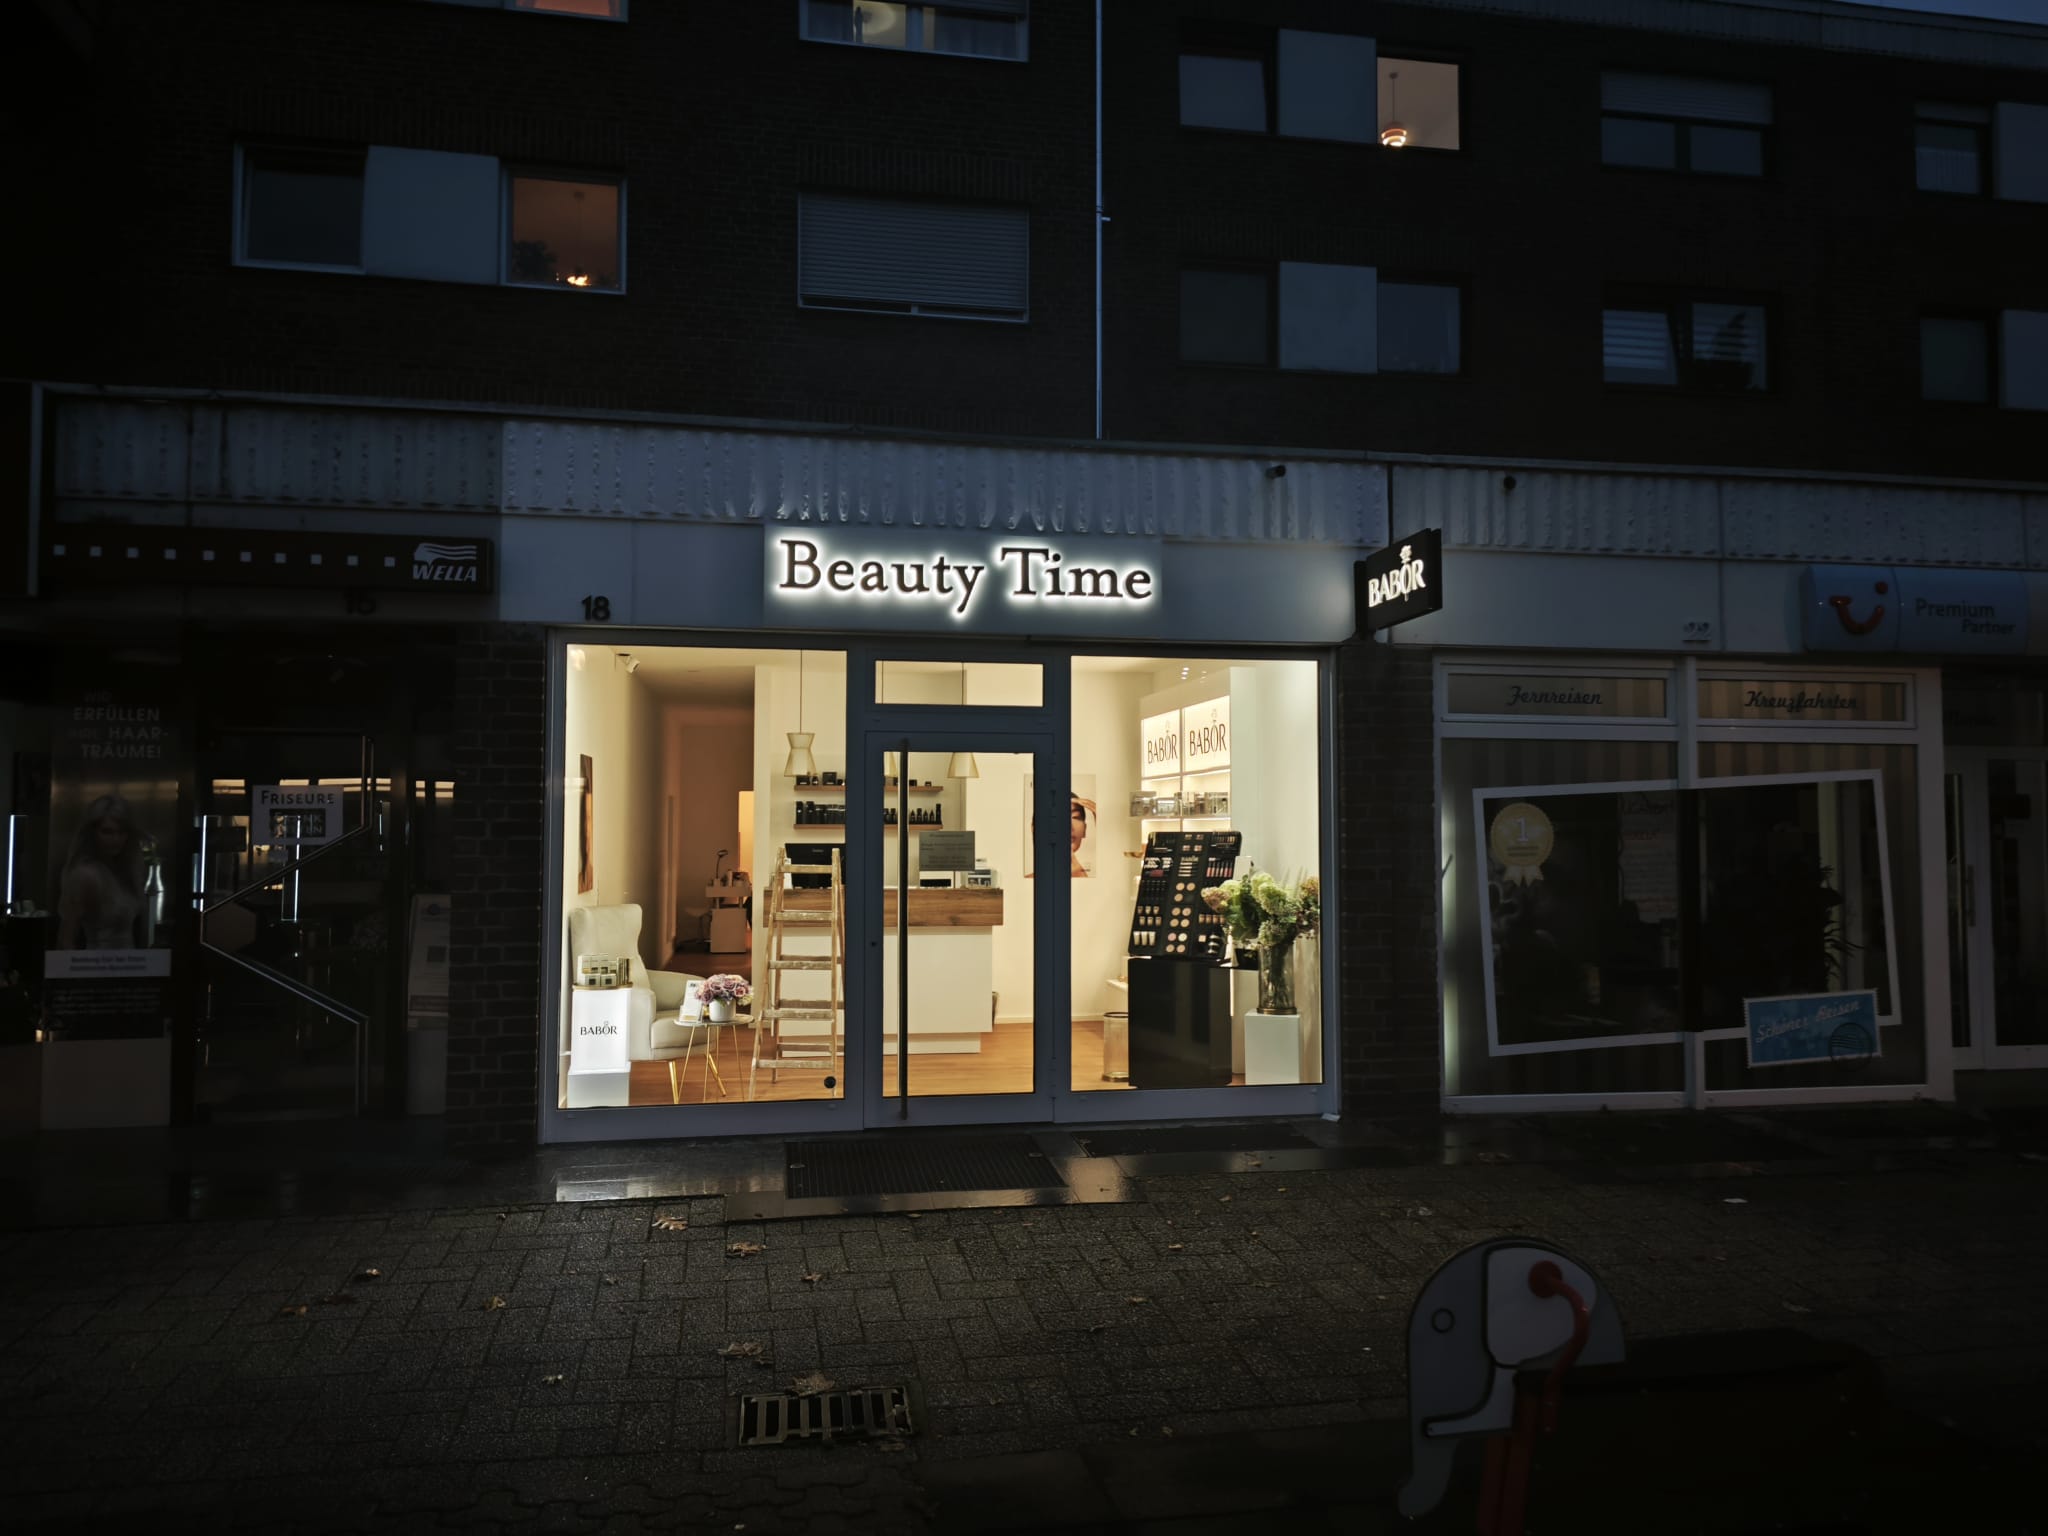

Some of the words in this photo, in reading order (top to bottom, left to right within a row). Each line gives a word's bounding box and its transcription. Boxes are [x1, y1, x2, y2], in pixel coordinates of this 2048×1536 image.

[412, 561, 478, 582] WELLA
[779, 539, 985, 614] Beauty
[1000, 547, 1153, 600] Time
[1367, 558, 1427, 608] BABOR
[581, 595, 610, 621] 18
[1914, 598, 1995, 617] Premium
[1681, 617, 1713, 642] 22
[1961, 618, 2017, 635] Partner
[1505, 685, 1604, 706] Fernreisen
[1743, 690, 1858, 713] Kreuzfahrten
[108, 725, 169, 741] HAAR-
[1188, 723, 1228, 757] BABOR
[80, 741, 162, 760] TRÄUME!
[1147, 733, 1179, 765] BABOR
[261, 790, 335, 805] FRISEURE
[579, 1024, 618, 1036] BABOR
